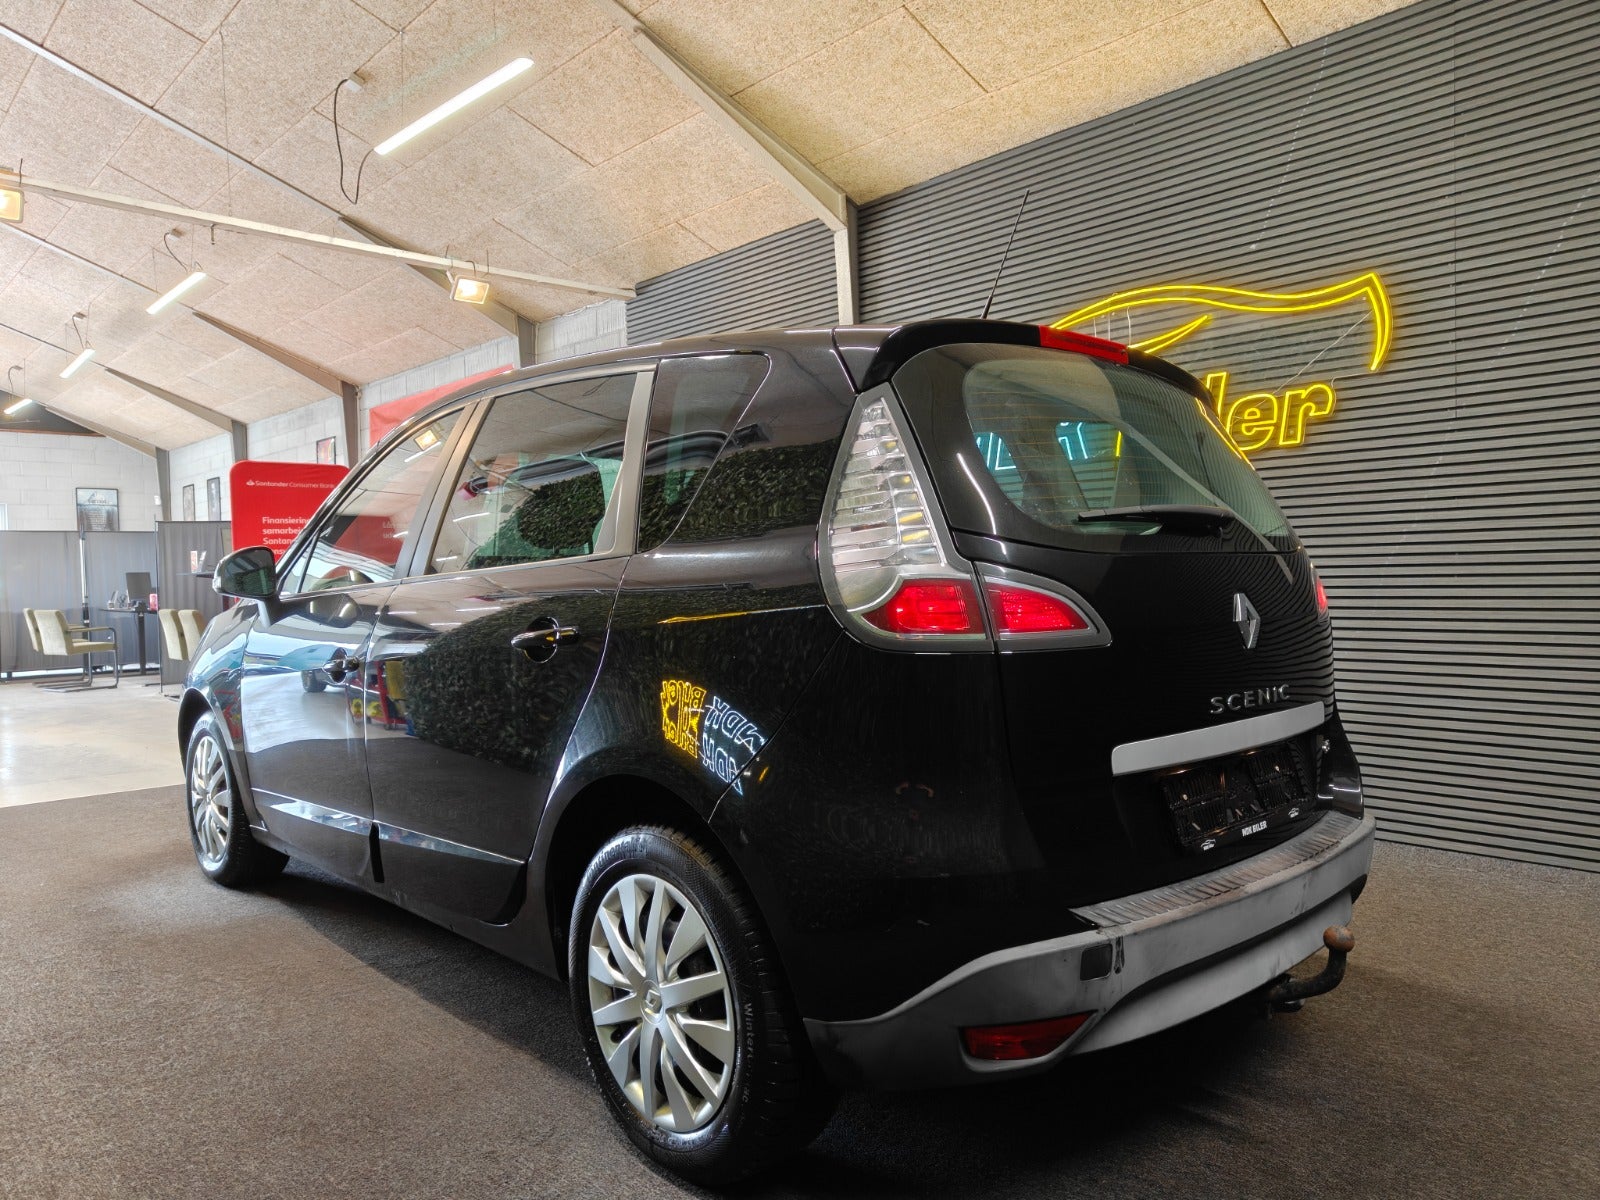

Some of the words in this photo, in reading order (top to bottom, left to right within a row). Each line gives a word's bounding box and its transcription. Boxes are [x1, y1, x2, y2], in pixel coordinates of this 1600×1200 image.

[1201, 371, 1334, 451] ler
[263, 537, 295, 545] Santan
[1210, 684, 1290, 714] SCENIC
